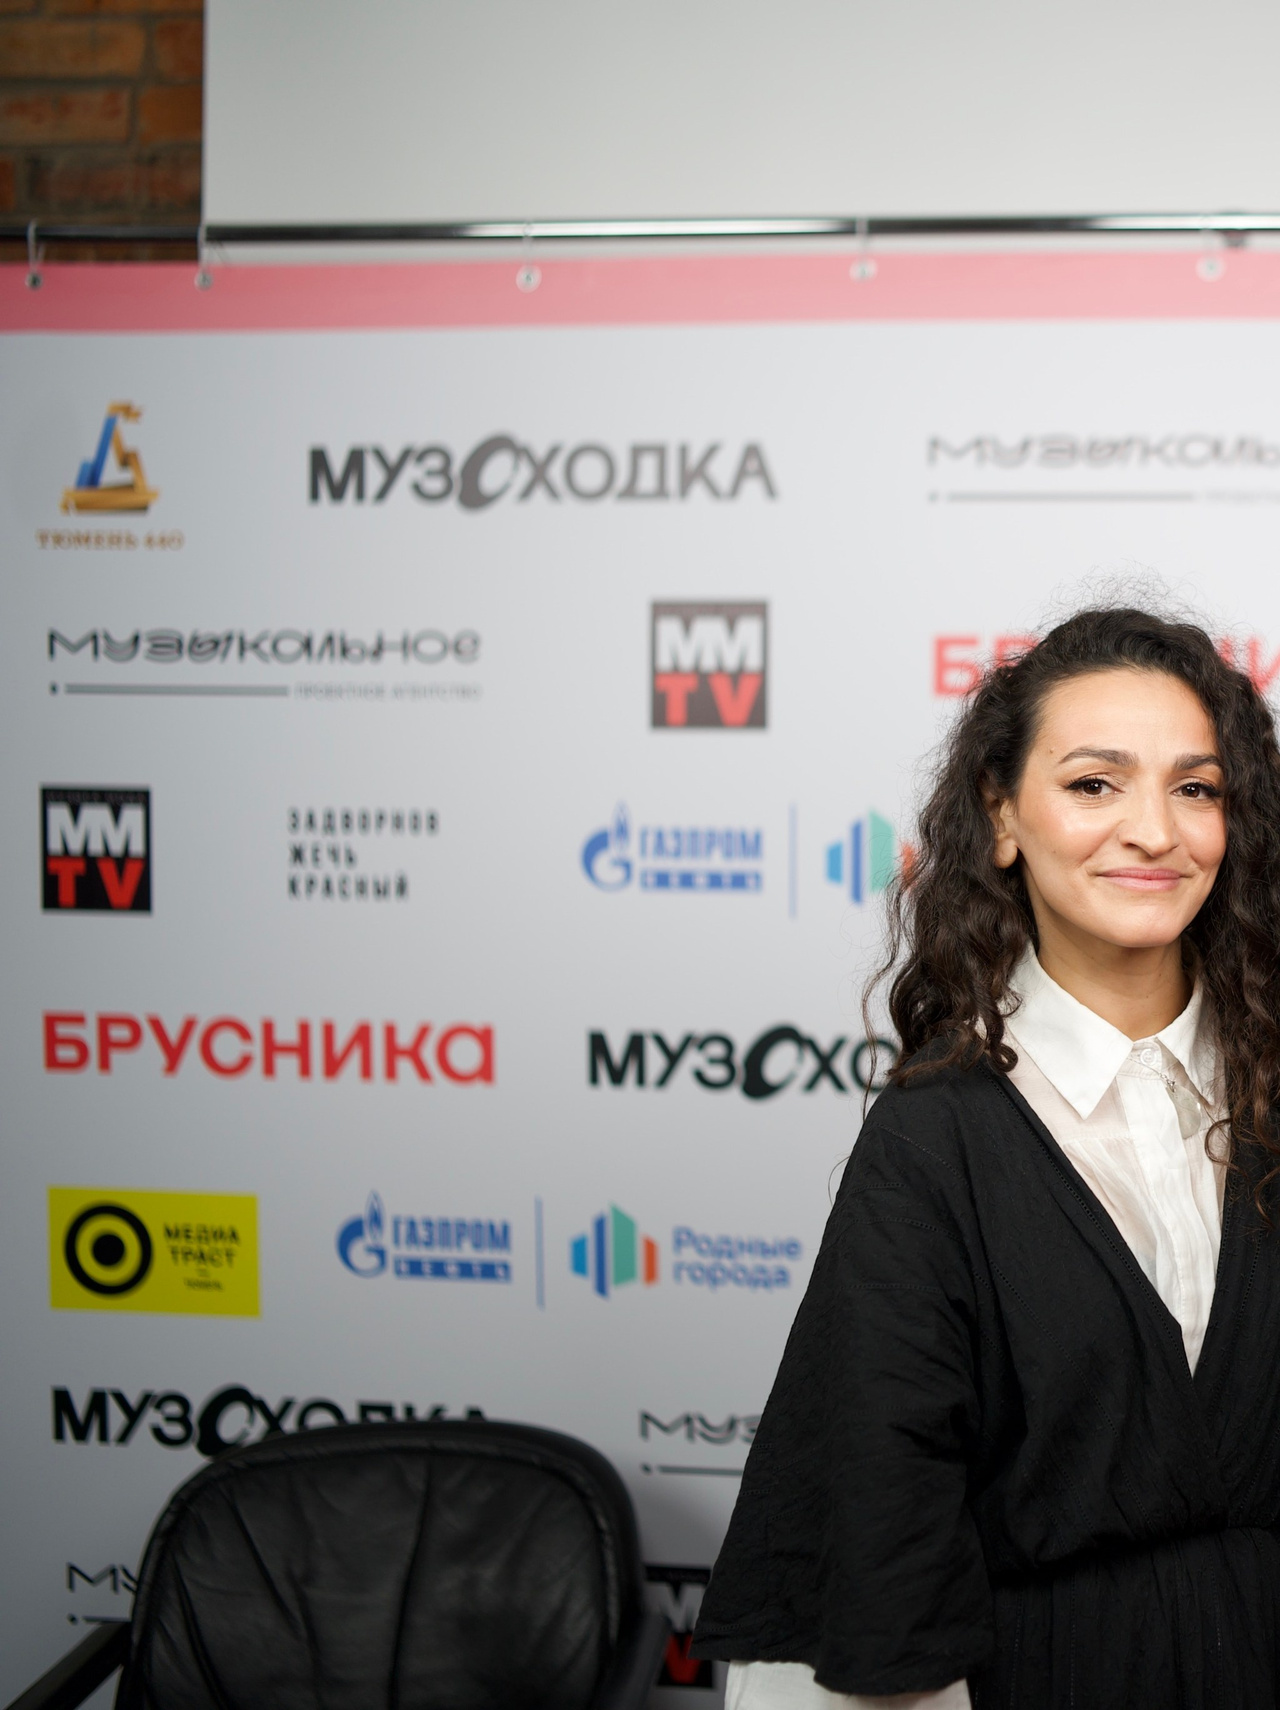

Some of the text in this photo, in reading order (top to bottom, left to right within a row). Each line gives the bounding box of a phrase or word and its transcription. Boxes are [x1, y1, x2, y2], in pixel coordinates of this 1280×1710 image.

[655, 671, 763, 727] TV
[287, 806, 440, 837] ЗАДВОРНОВ
[288, 842, 358, 869] ЖЕЧЬ
[639, 826, 763, 862] ГАЗПРОМ
[46, 857, 145, 910] TV
[287, 871, 409, 901] КРАСНЫЙ
[391, 1214, 512, 1254] ГАЗПРОМ
[671, 1225, 801, 1262] Родные
[671, 1260, 793, 1292] города
